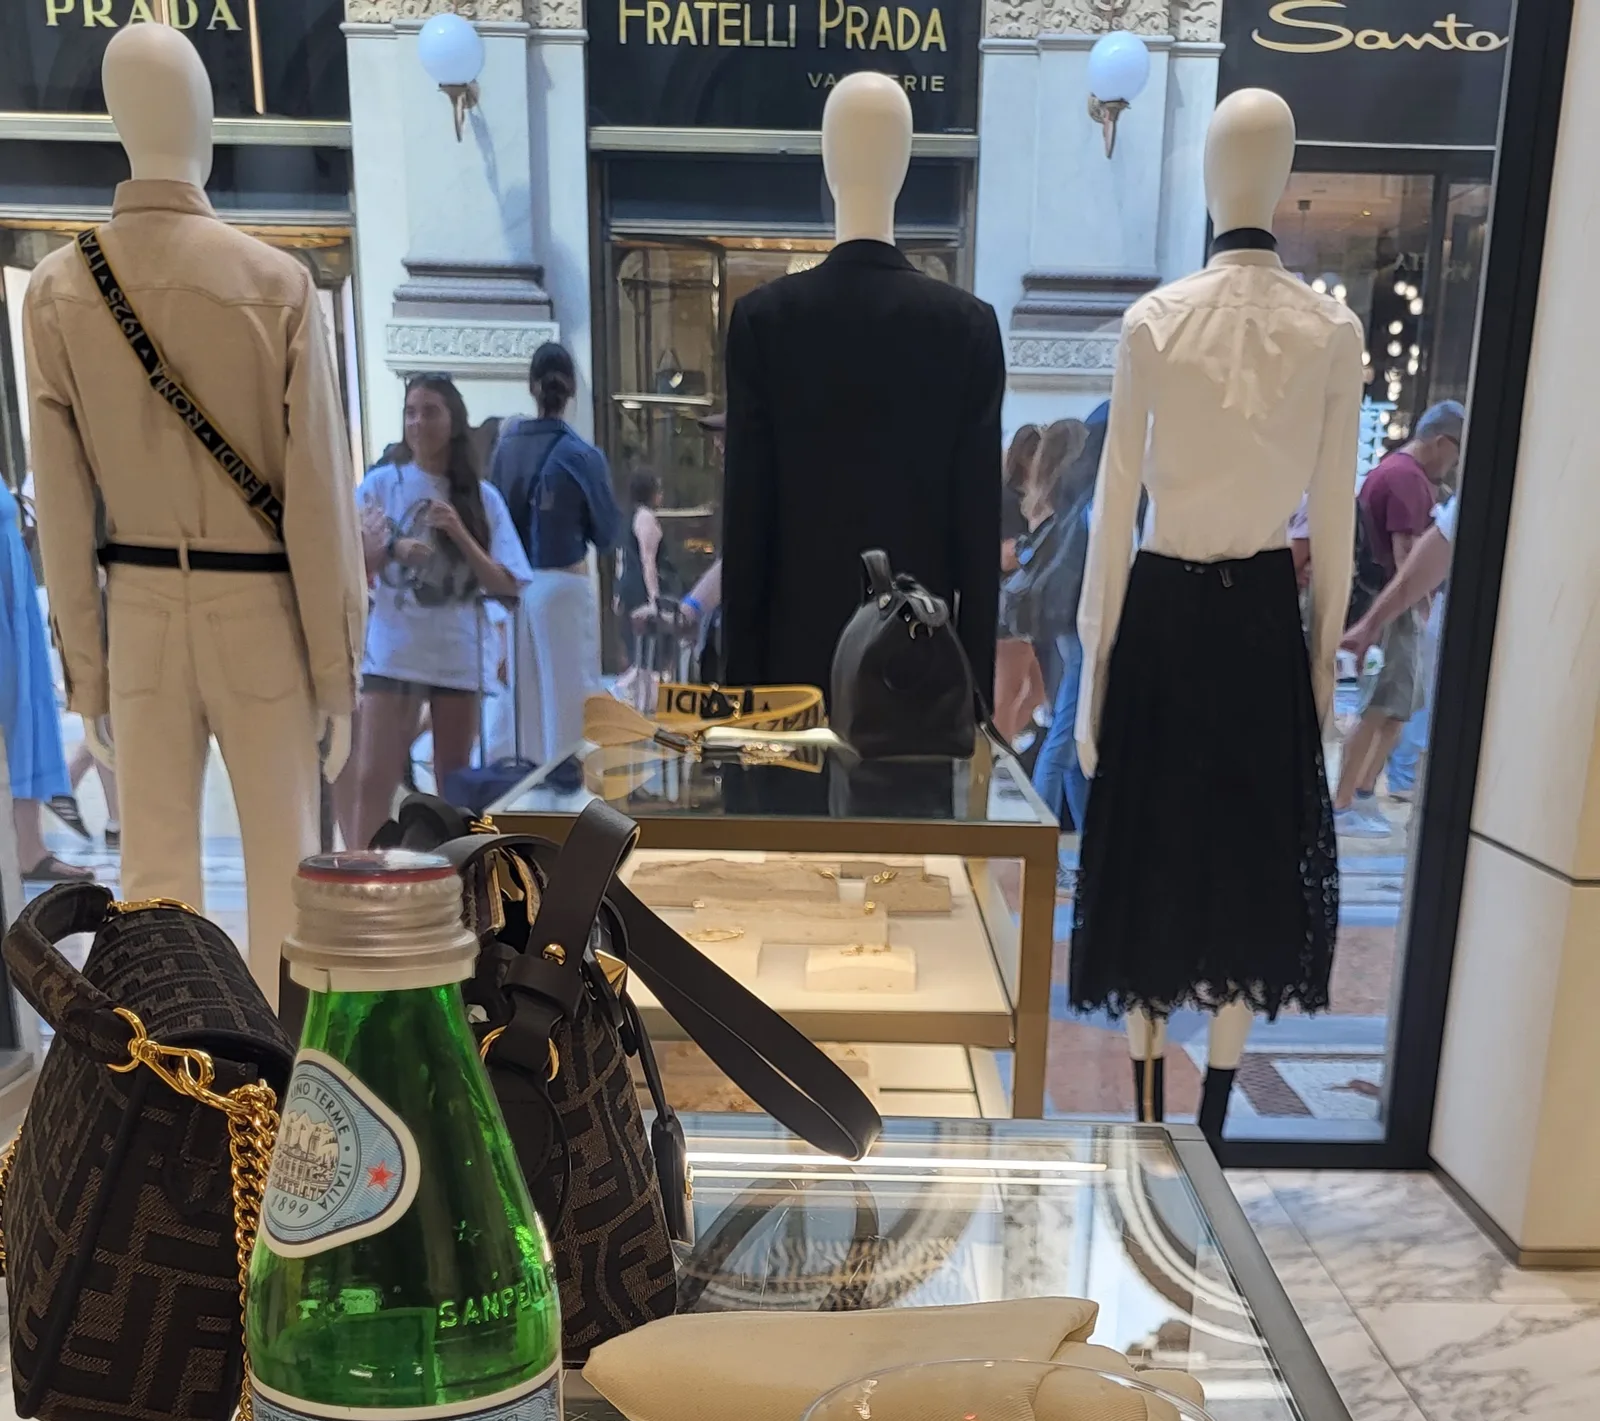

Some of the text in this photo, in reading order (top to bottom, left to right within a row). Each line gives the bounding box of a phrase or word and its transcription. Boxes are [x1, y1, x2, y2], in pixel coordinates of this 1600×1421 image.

[45, 0, 242, 31] PRADA
[618, 0, 948, 53] FRATELLI PRADA
[807, 72, 945, 92] VARIE
[108, 286, 145, 343] 1925
[314, 1087, 350, 1136] TERME
[271, 1194, 310, 1219] 1899
[317, 1163, 353, 1211] ITALIA
